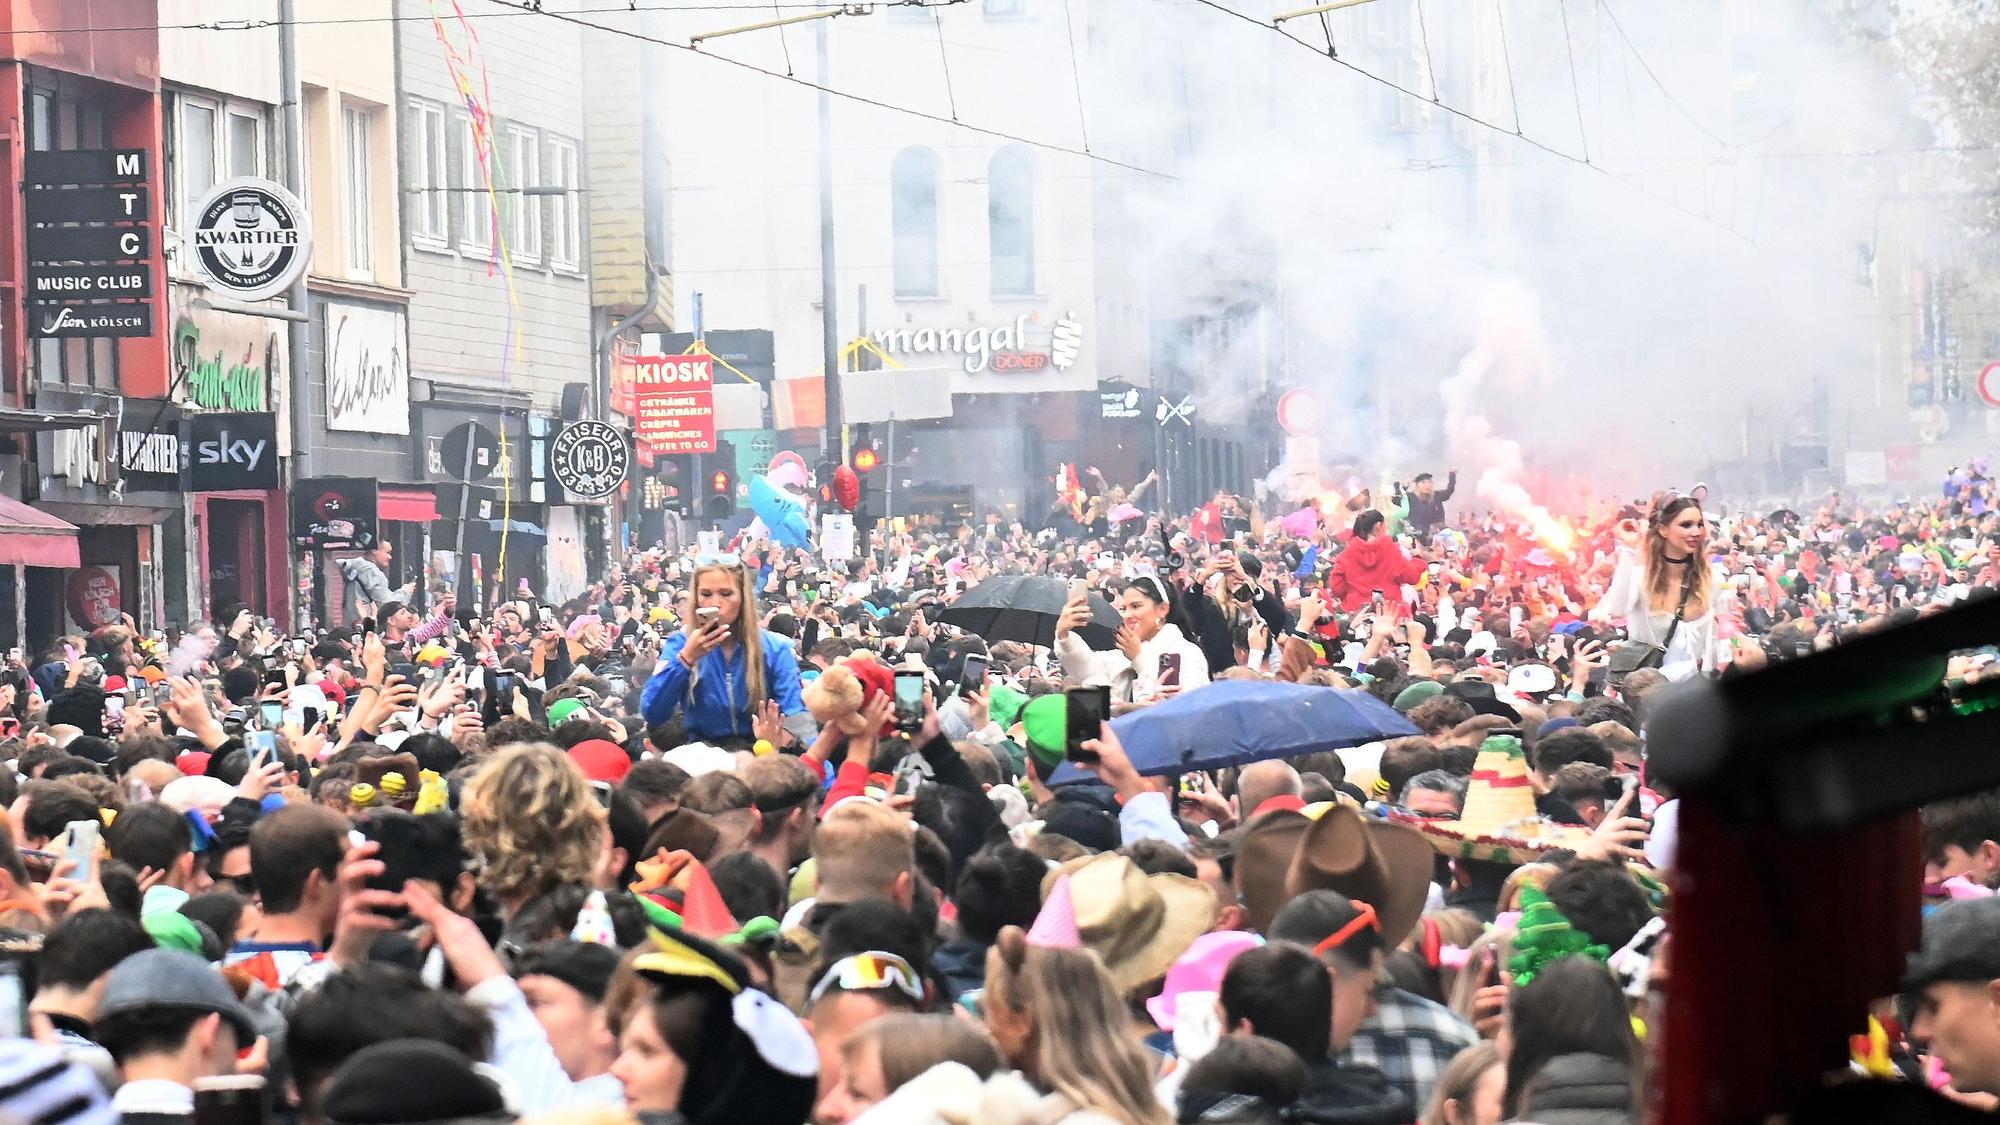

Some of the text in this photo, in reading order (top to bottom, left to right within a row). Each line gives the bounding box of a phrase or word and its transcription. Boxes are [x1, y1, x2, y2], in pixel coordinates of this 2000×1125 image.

[116, 154, 139, 175] M
[120, 194, 137, 214] T
[120, 233, 139, 254] C
[195, 231, 298, 245] KWARTIER
[37, 275, 143, 290] MUSIC CLUB
[90, 315, 142, 327] KÖLSCH
[874, 313, 1030, 373] mangal
[636, 361, 709, 384] KIOSK
[557, 424, 622, 453] FRISEUR
[679, 441, 692, 449] TO
[694, 440, 708, 449] GO
[122, 430, 178, 474] KWARTIER
[199, 430, 266, 471] sky
[577, 444, 604, 473] K&B
